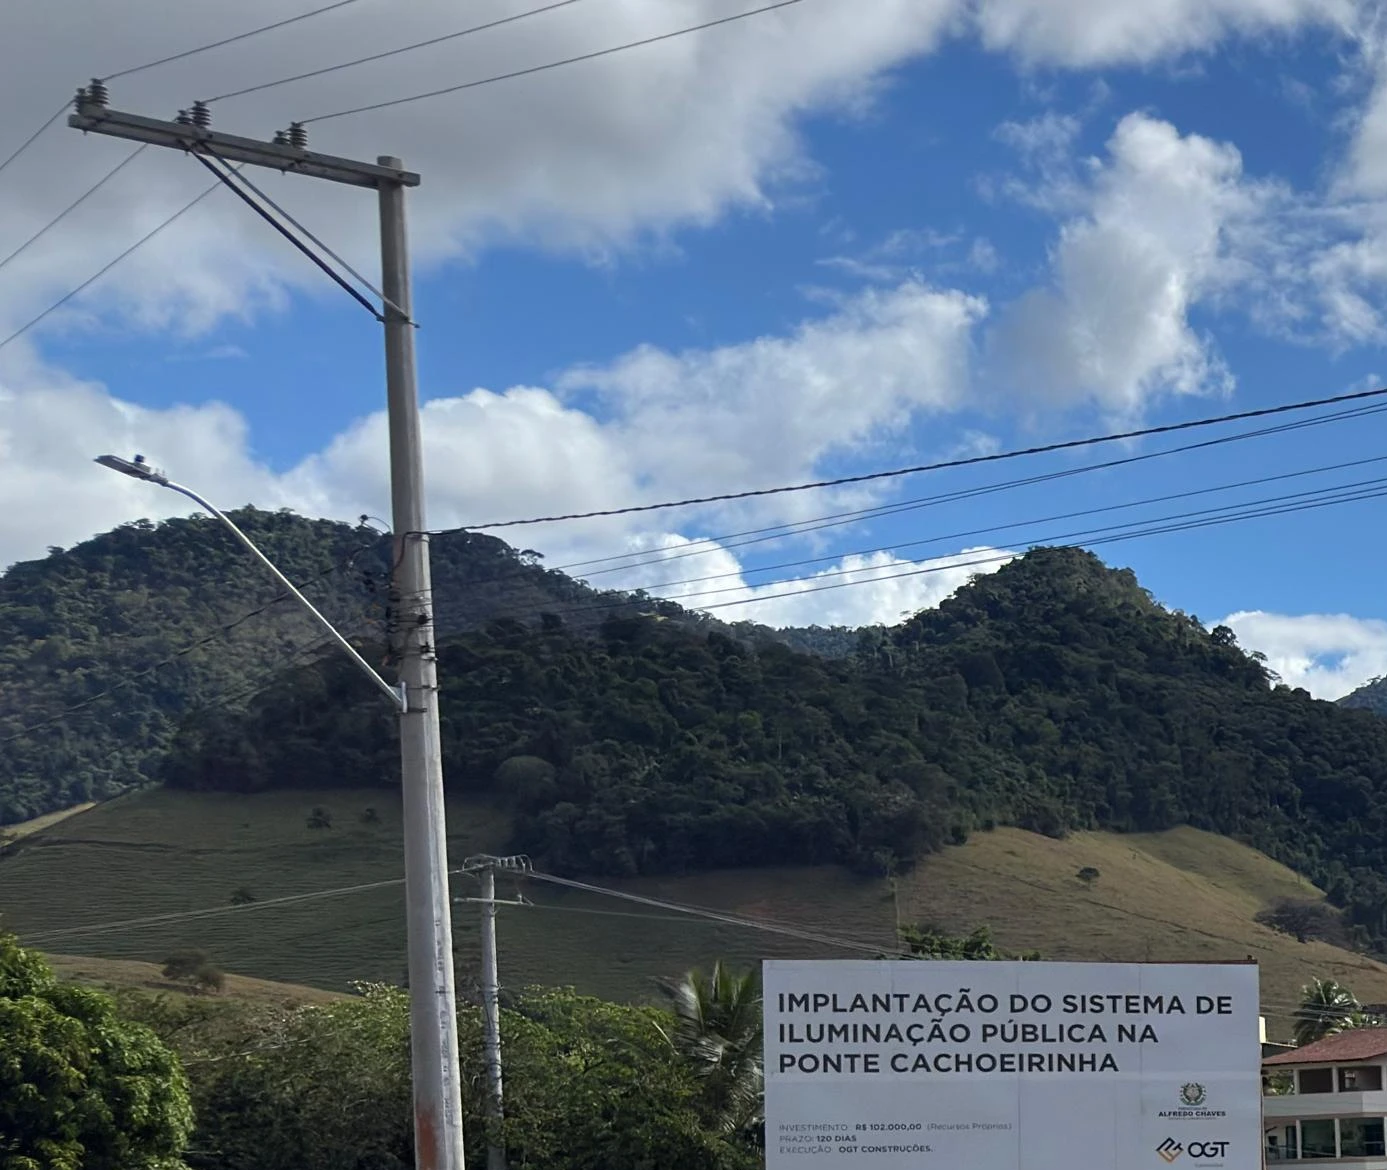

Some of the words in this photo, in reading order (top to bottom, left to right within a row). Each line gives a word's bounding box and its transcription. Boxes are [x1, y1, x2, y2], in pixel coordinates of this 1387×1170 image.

[778, 988, 999, 1016] IMPLANTAÇÃO
[1009, 994, 1052, 1014] DO
[1062, 994, 1186, 1015] SISTEMA
[1195, 995, 1233, 1015] DE
[778, 1018, 971, 1046] ILUMINAÇÃO
[982, 1019, 1107, 1043] PÚBLICA
[1117, 1024, 1159, 1043] NA
[779, 1053, 880, 1073] PONTE
[890, 1053, 1120, 1073] CACHOEIRINHA
[855, 1123, 868, 1132] R$
[870, 1123, 921, 1132] 102.000,00
[817, 1135, 832, 1143] 120
[835, 1135, 856, 1143] DIAS
[838, 1145, 859, 1153] OGT
[1188, 1142, 1229, 1157] OGT
